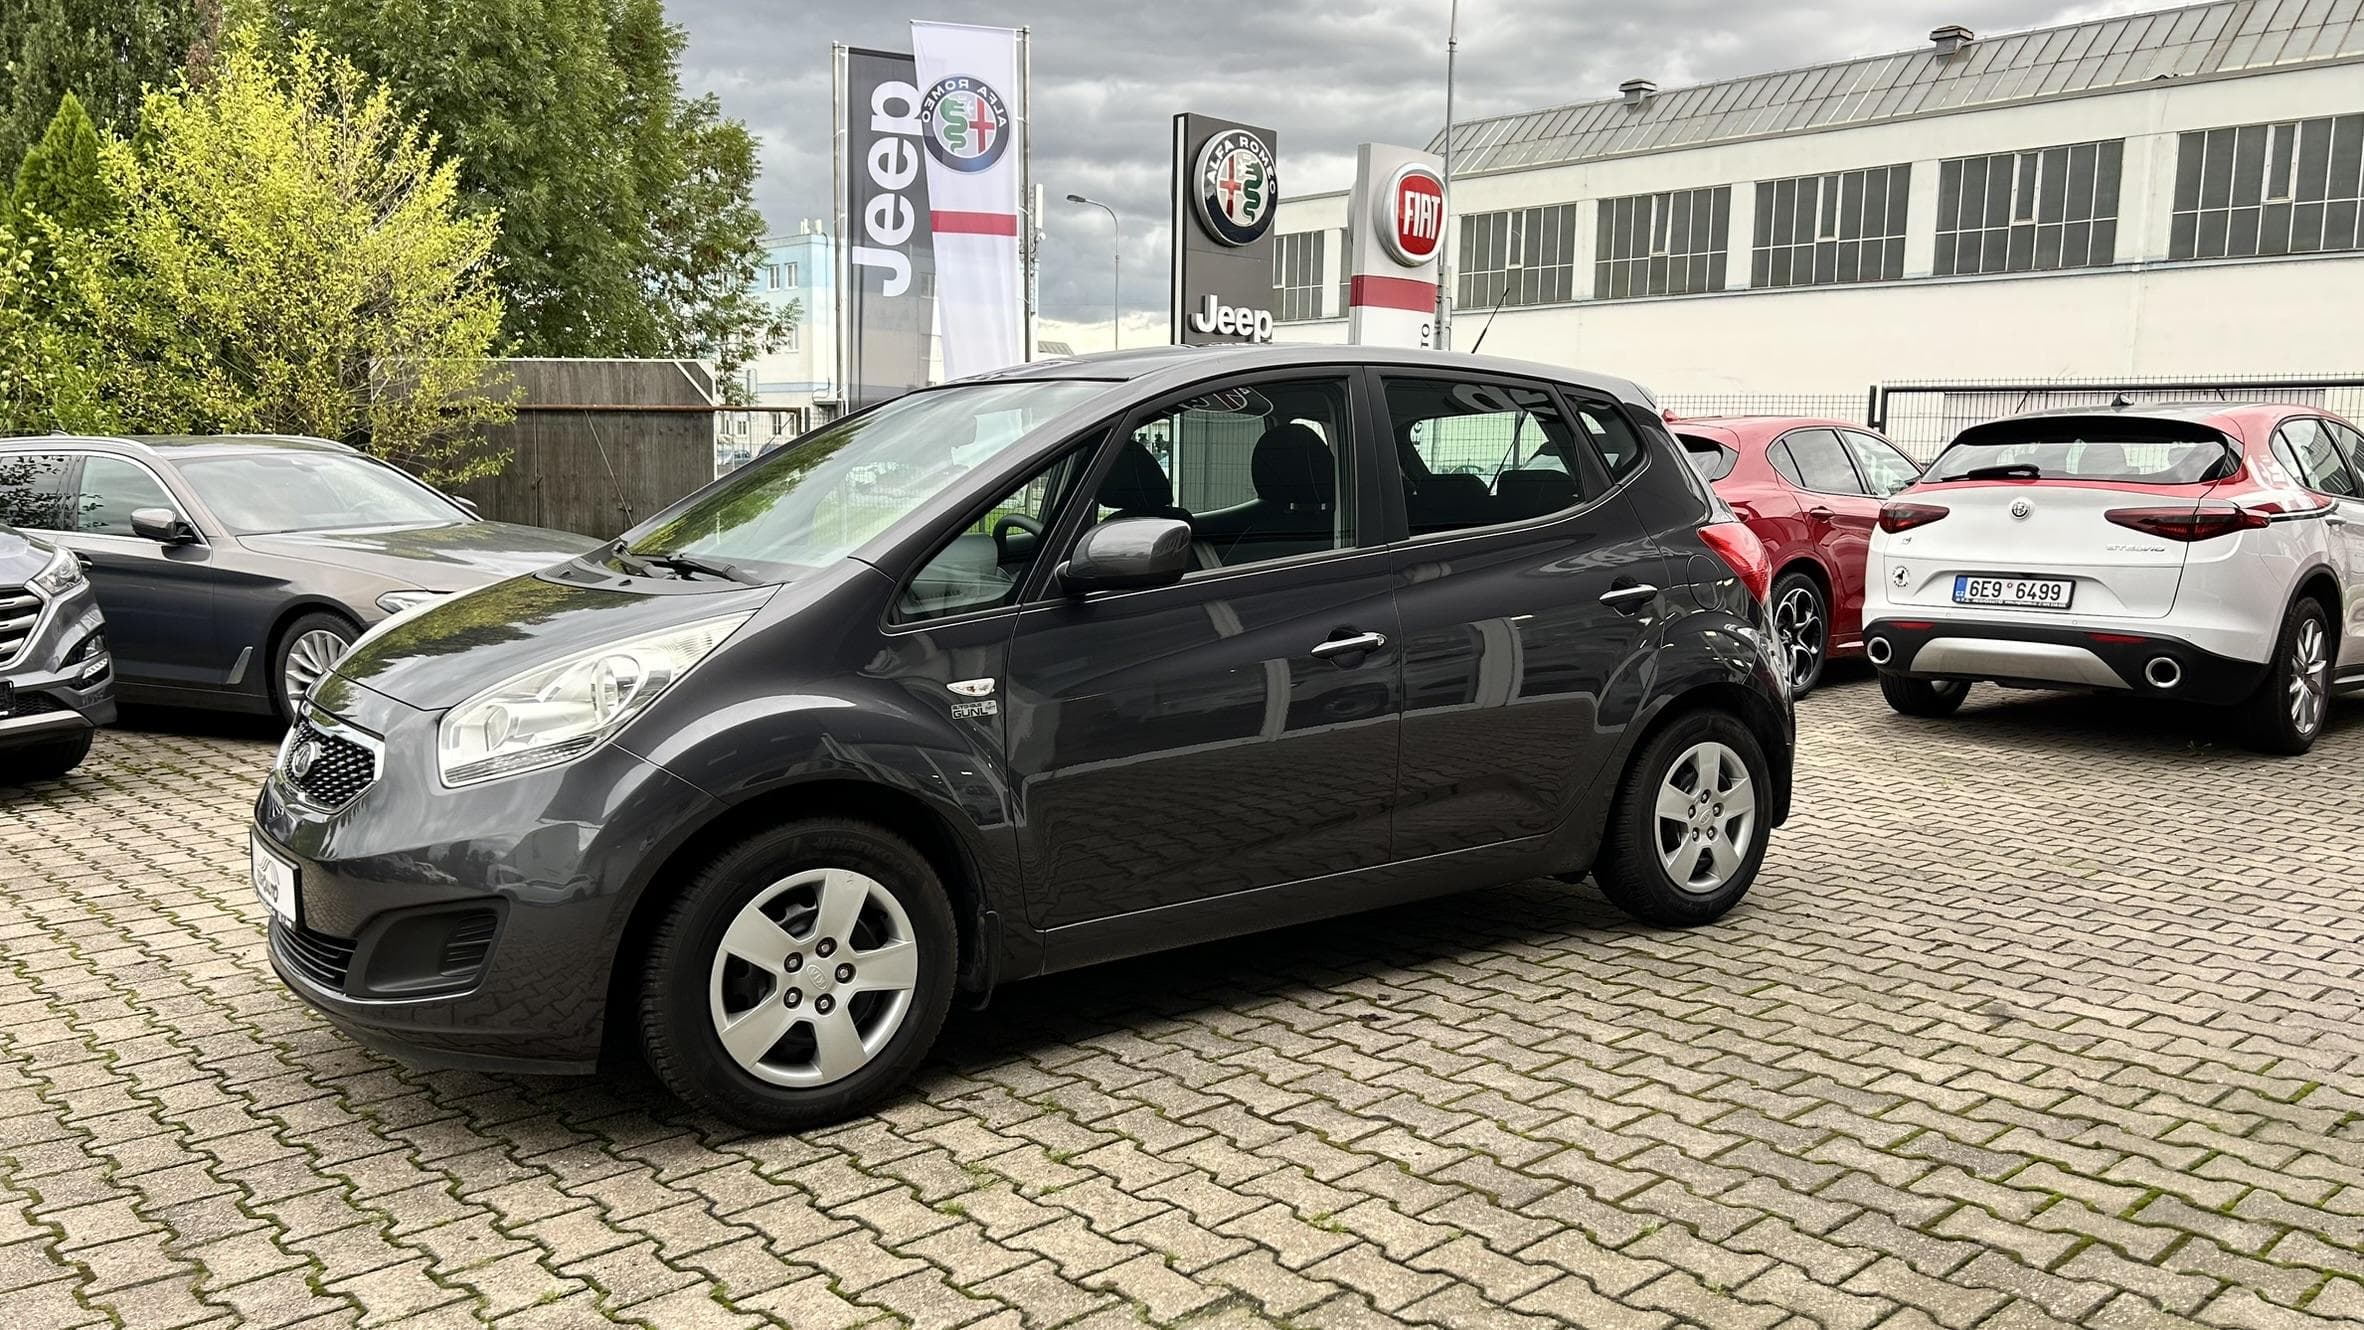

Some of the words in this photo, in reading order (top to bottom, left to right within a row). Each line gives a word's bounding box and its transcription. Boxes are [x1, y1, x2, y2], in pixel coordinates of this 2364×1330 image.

[851, 80, 924, 297] Jeep
[1206, 139, 1235, 185] ALFA
[1239, 135, 1276, 194] ROMEO
[1402, 190, 1441, 240] FIAT
[1194, 294, 1273, 342] Jeep
[1969, 580, 2002, 598] 6E9
[2015, 582, 2061, 601] 6499
